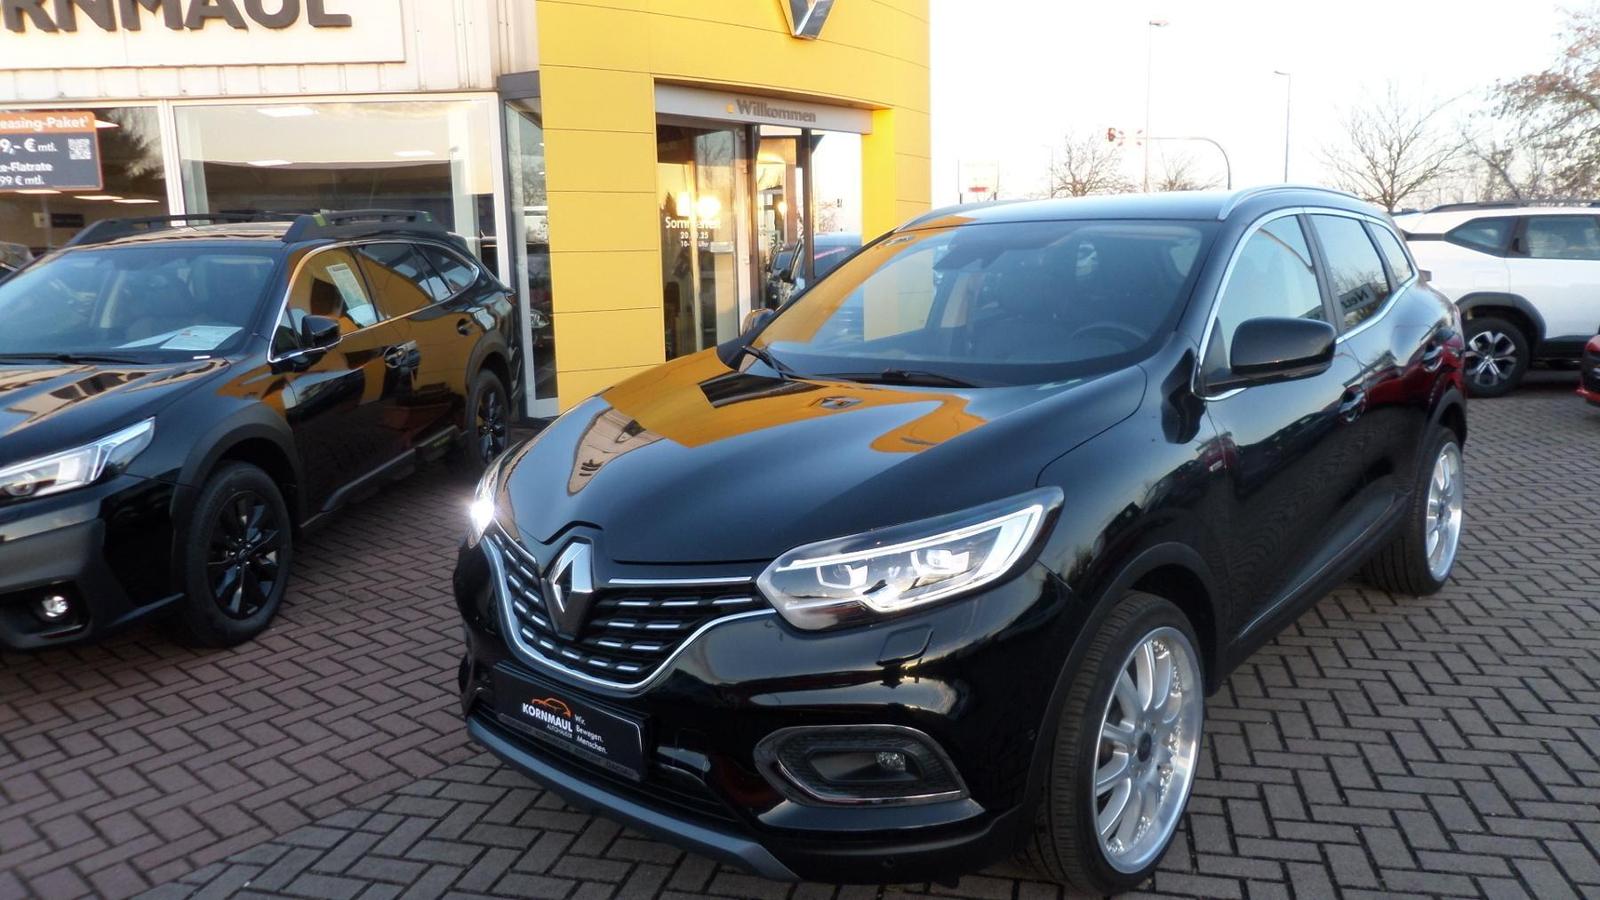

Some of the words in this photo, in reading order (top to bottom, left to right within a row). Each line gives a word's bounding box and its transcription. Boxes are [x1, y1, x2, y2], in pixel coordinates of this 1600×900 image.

[736, 98, 817, 122] Willkommen
[522, 702, 573, 733] KORNMAUL
[576, 724, 604, 743] Bewegen.
[576, 735, 608, 754] Menschen.
